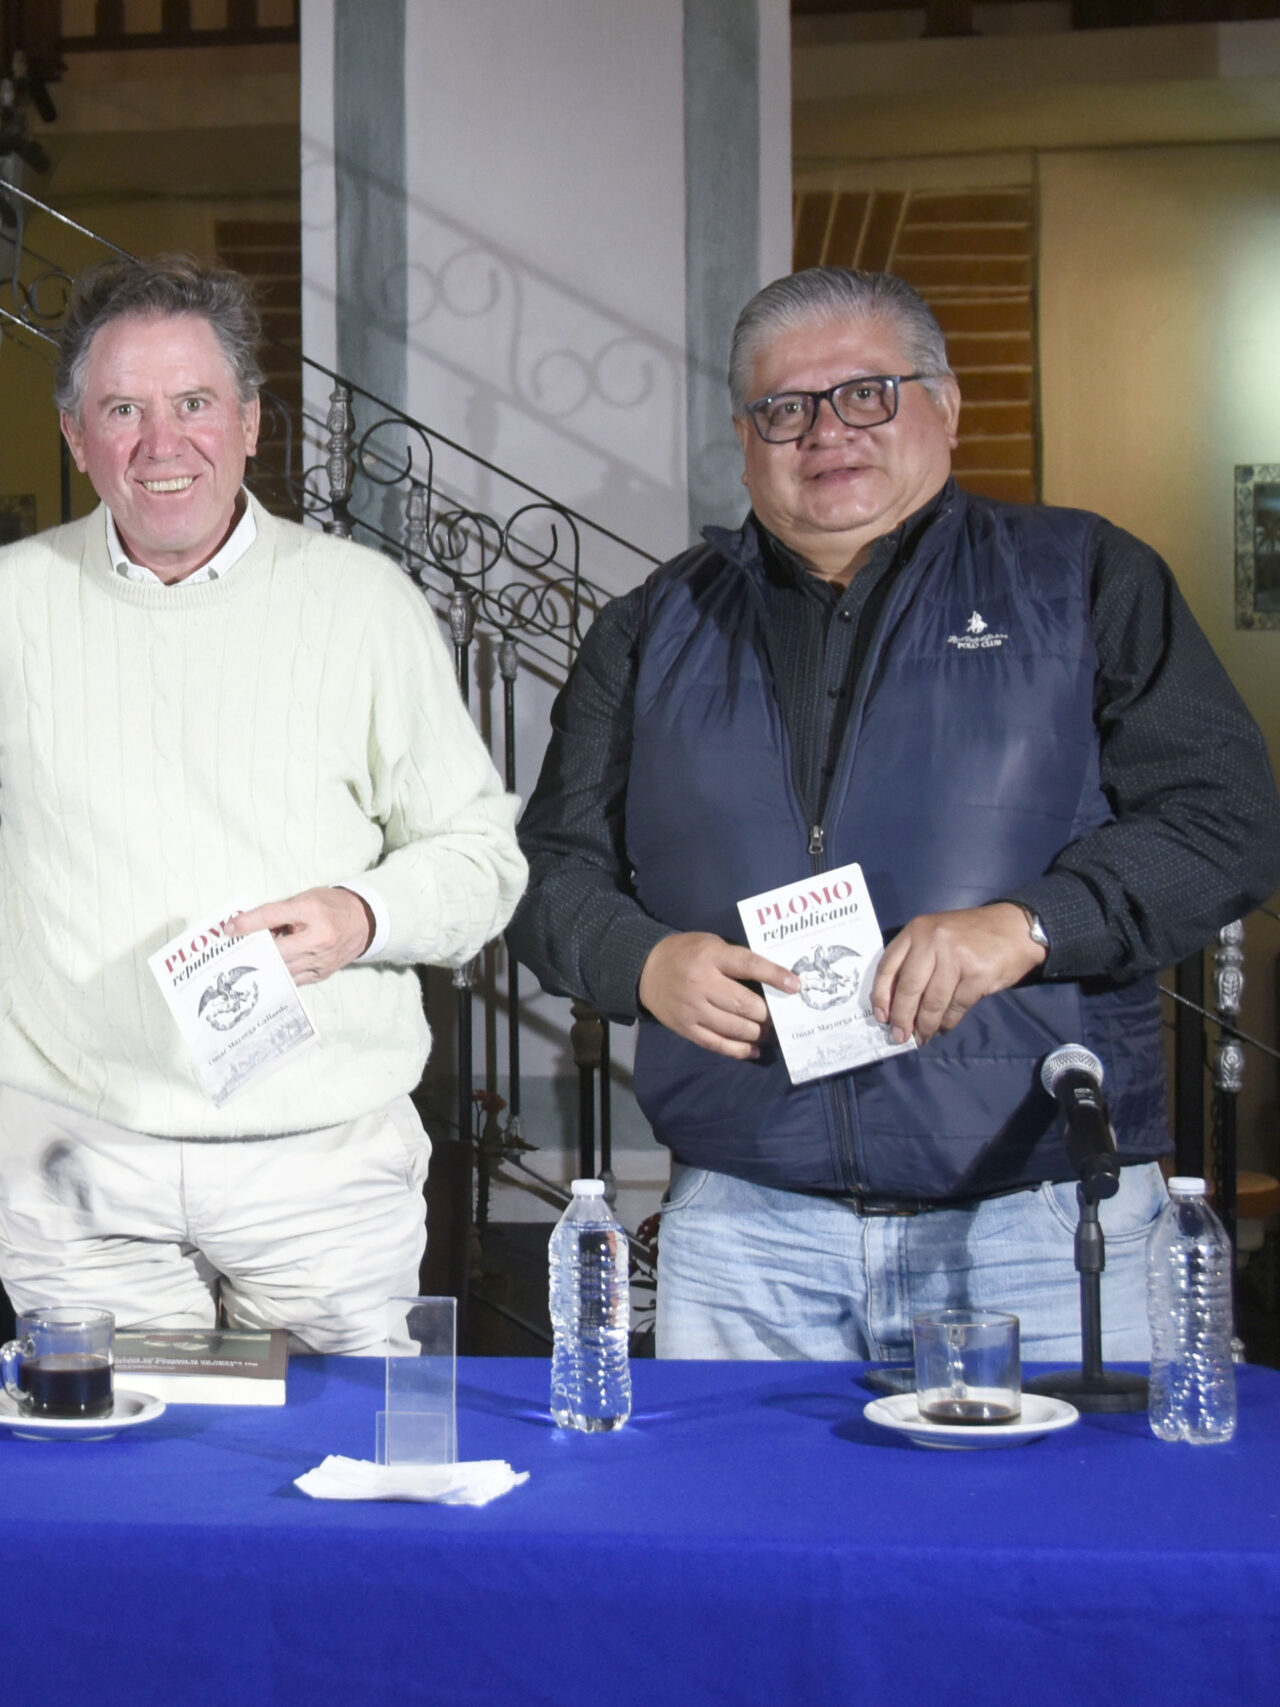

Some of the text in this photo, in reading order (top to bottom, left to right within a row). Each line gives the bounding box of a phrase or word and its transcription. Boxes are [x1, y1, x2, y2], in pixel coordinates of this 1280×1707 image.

[957, 639, 1002, 649] POLO CLUB
[756, 880, 853, 926] PLOMO
[763, 902, 859, 942] republicano
[165, 910, 246, 974] PLOM
[791, 1028, 816, 1041] Omar
[816, 1016, 853, 1033] Mayorga
